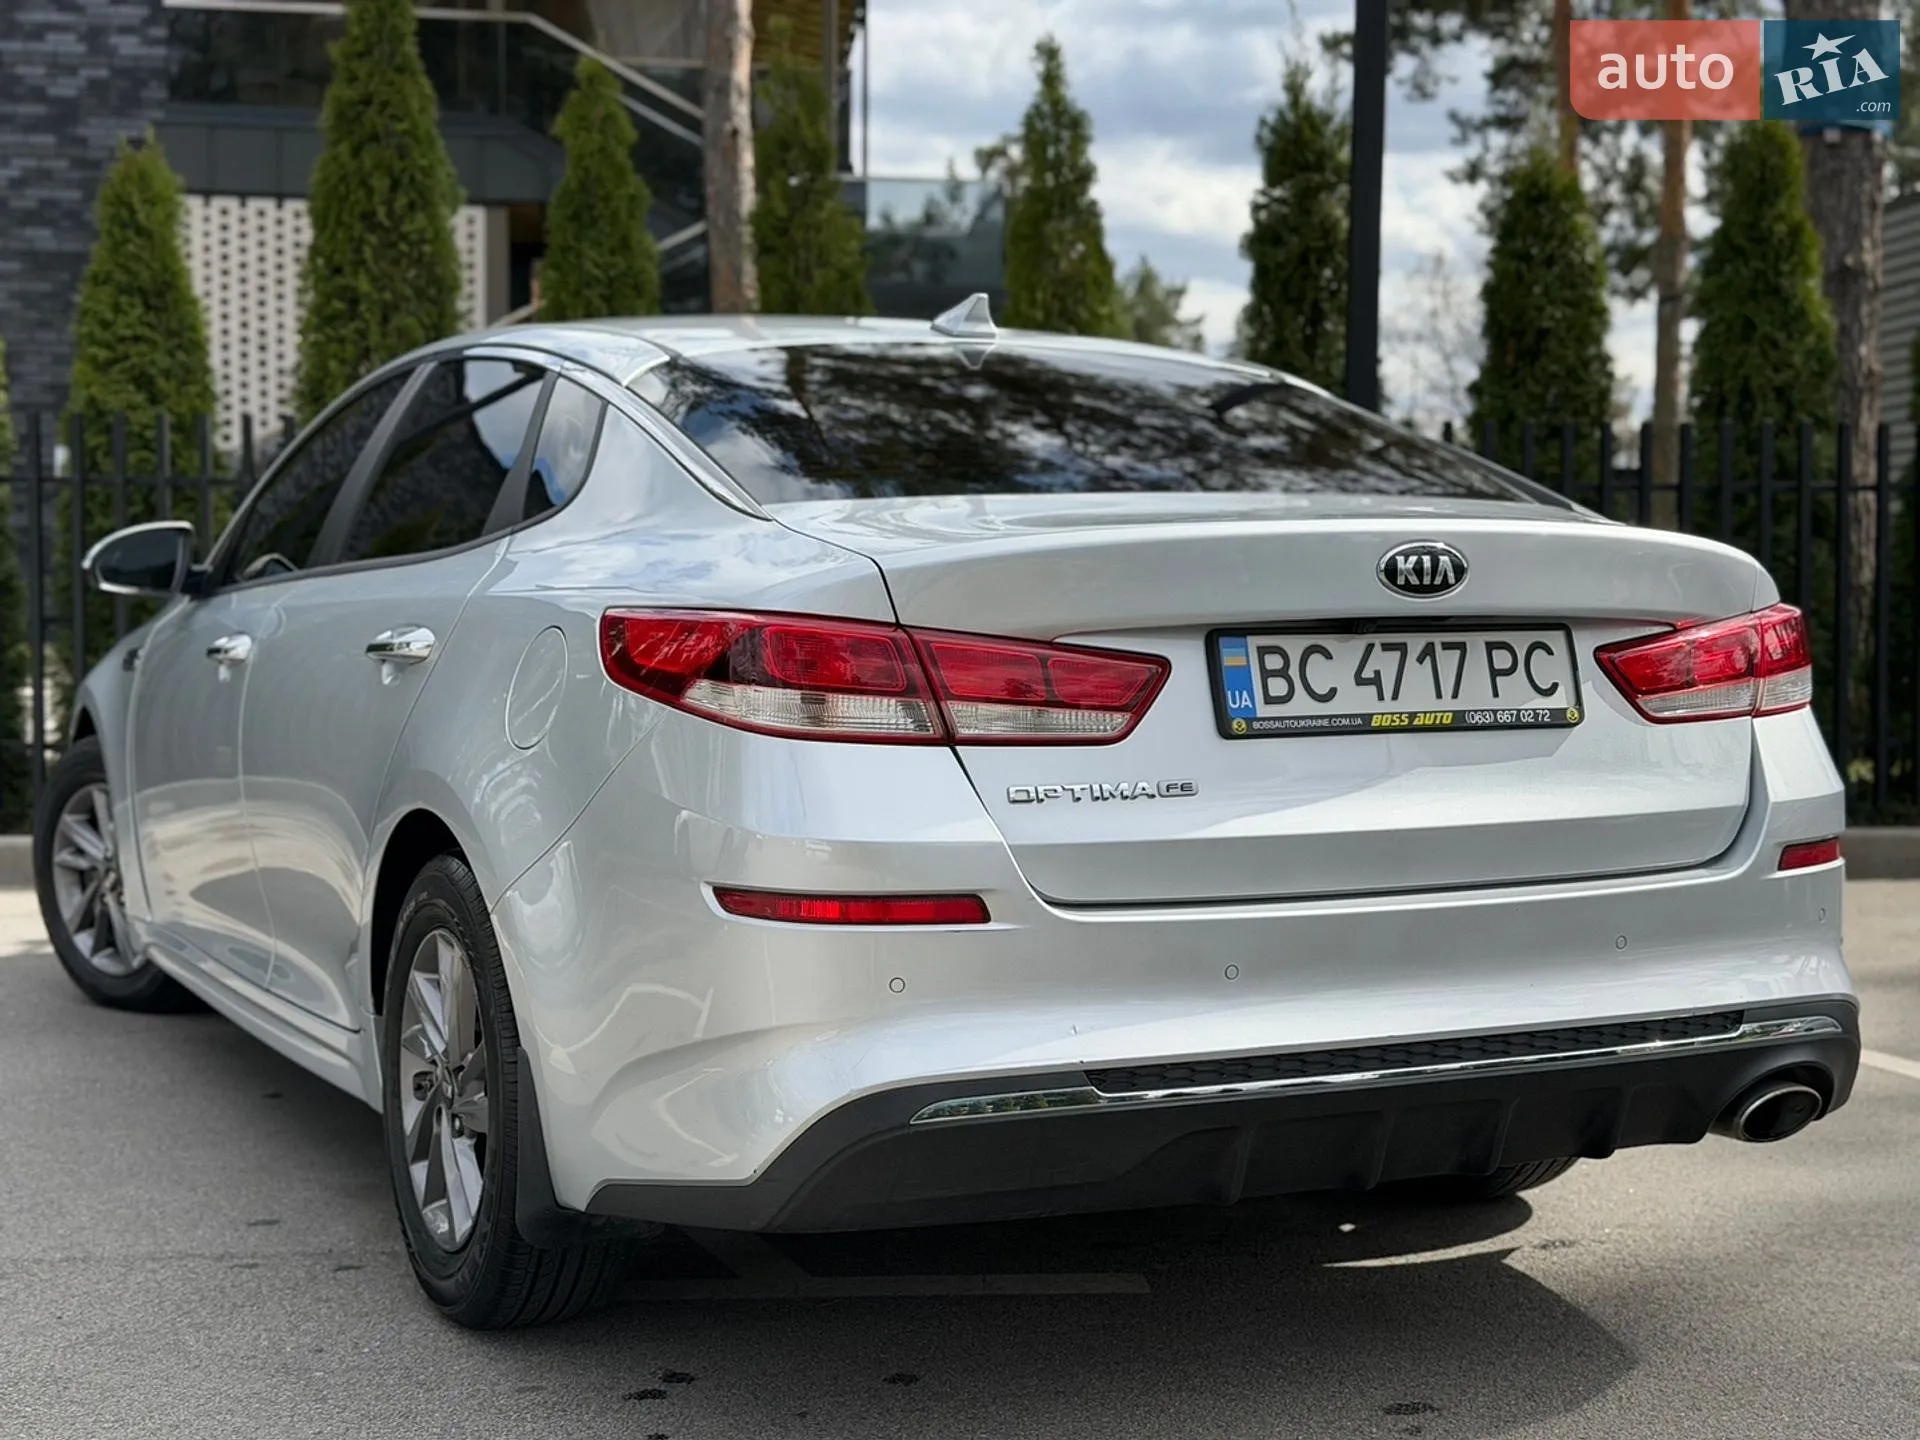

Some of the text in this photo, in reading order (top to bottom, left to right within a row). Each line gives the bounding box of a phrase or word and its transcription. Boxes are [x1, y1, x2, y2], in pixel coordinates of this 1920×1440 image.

[1395, 555, 1456, 586] KIA
[1256, 640, 1560, 705] BC 4717 PC
[1228, 690, 1253, 709] UA
[1252, 708, 1551, 730] BOSSAUTOUKRAINE.COM.UA BOSS AUTO (063) 667 02 72
[1007, 782, 1194, 804] OPTIMA FE
